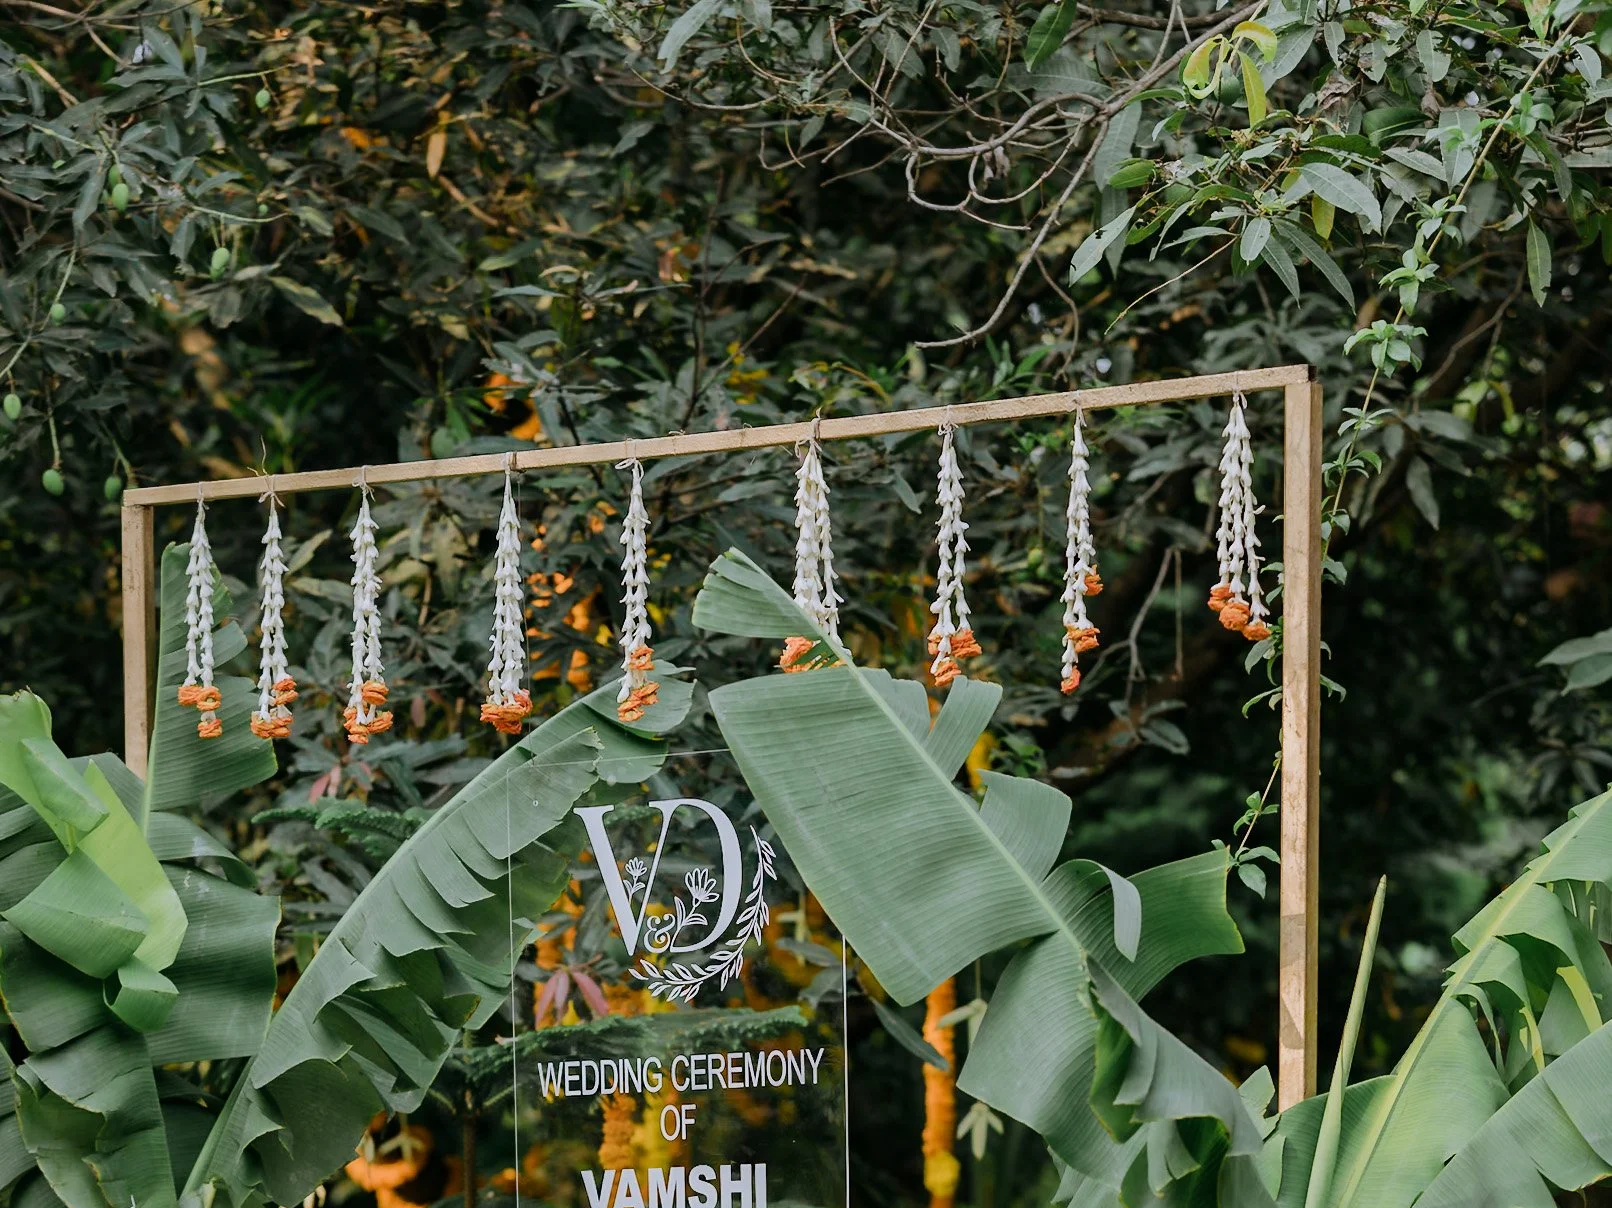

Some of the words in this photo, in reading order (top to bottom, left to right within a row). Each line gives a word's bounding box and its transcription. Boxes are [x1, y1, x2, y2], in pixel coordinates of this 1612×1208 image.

[537, 1056, 662, 1097] WEDDING
[670, 1048, 824, 1092] CEREMONY
[660, 1104, 697, 1141] OF
